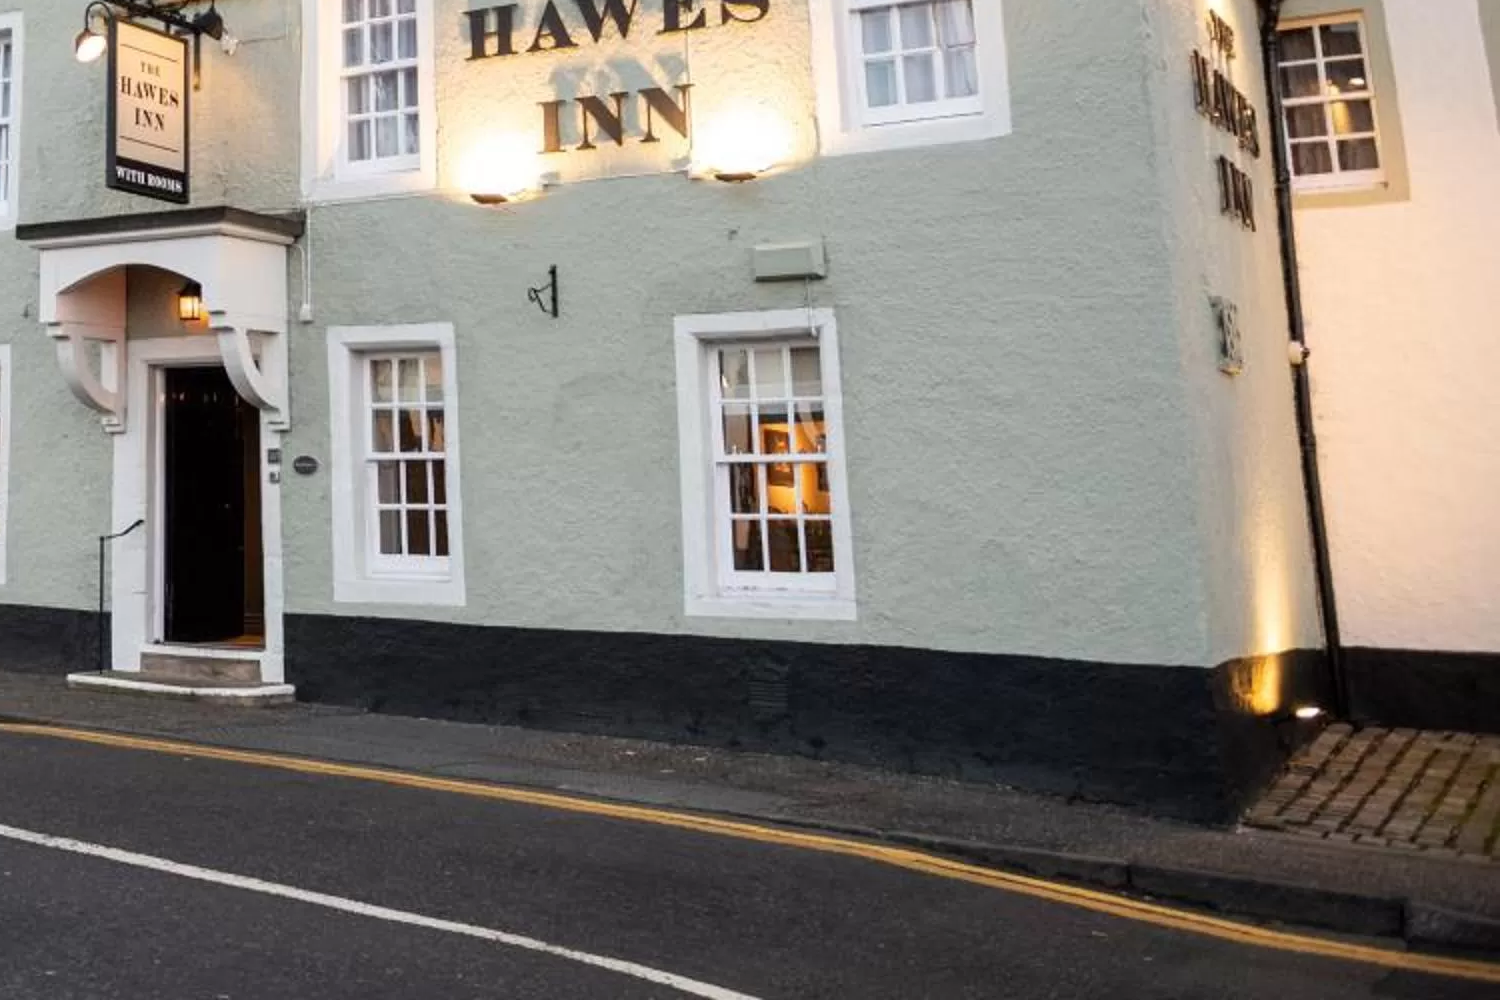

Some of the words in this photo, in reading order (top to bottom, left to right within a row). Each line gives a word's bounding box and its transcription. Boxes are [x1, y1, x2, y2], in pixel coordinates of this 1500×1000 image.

[1205, 8, 1236, 58] THE
[140, 60, 161, 77] THE
[120, 75, 179, 108] HAWES
[1189, 49, 1260, 159] HAWES
[135, 107, 165, 131] INN
[536, 83, 695, 154] INN
[116, 166, 146, 185] WITH
[147, 173, 184, 193] ROOMS
[1215, 154, 1256, 232] INN
